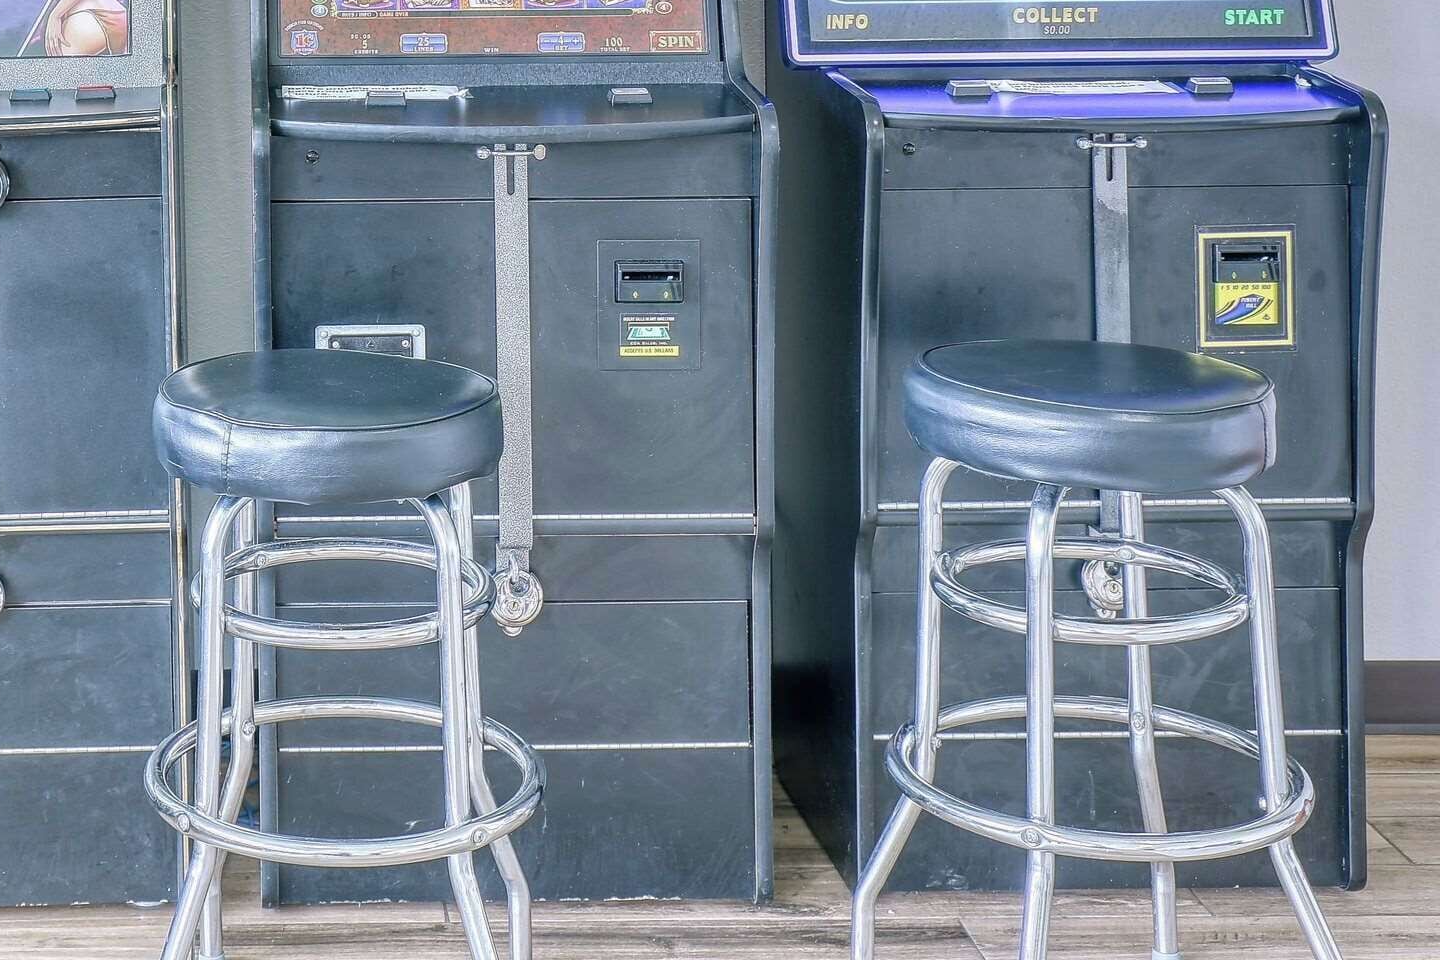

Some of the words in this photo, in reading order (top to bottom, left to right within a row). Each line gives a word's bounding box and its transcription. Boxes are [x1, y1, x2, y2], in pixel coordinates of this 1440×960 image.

[826, 14, 869, 30] INFO
[1012, 7, 1099, 24] COLLECT
[1224, 8, 1285, 26] START
[1043, 24, 1071, 35] $0.00
[604, 37, 623, 47] 100
[658, 35, 695, 48] SPIN
